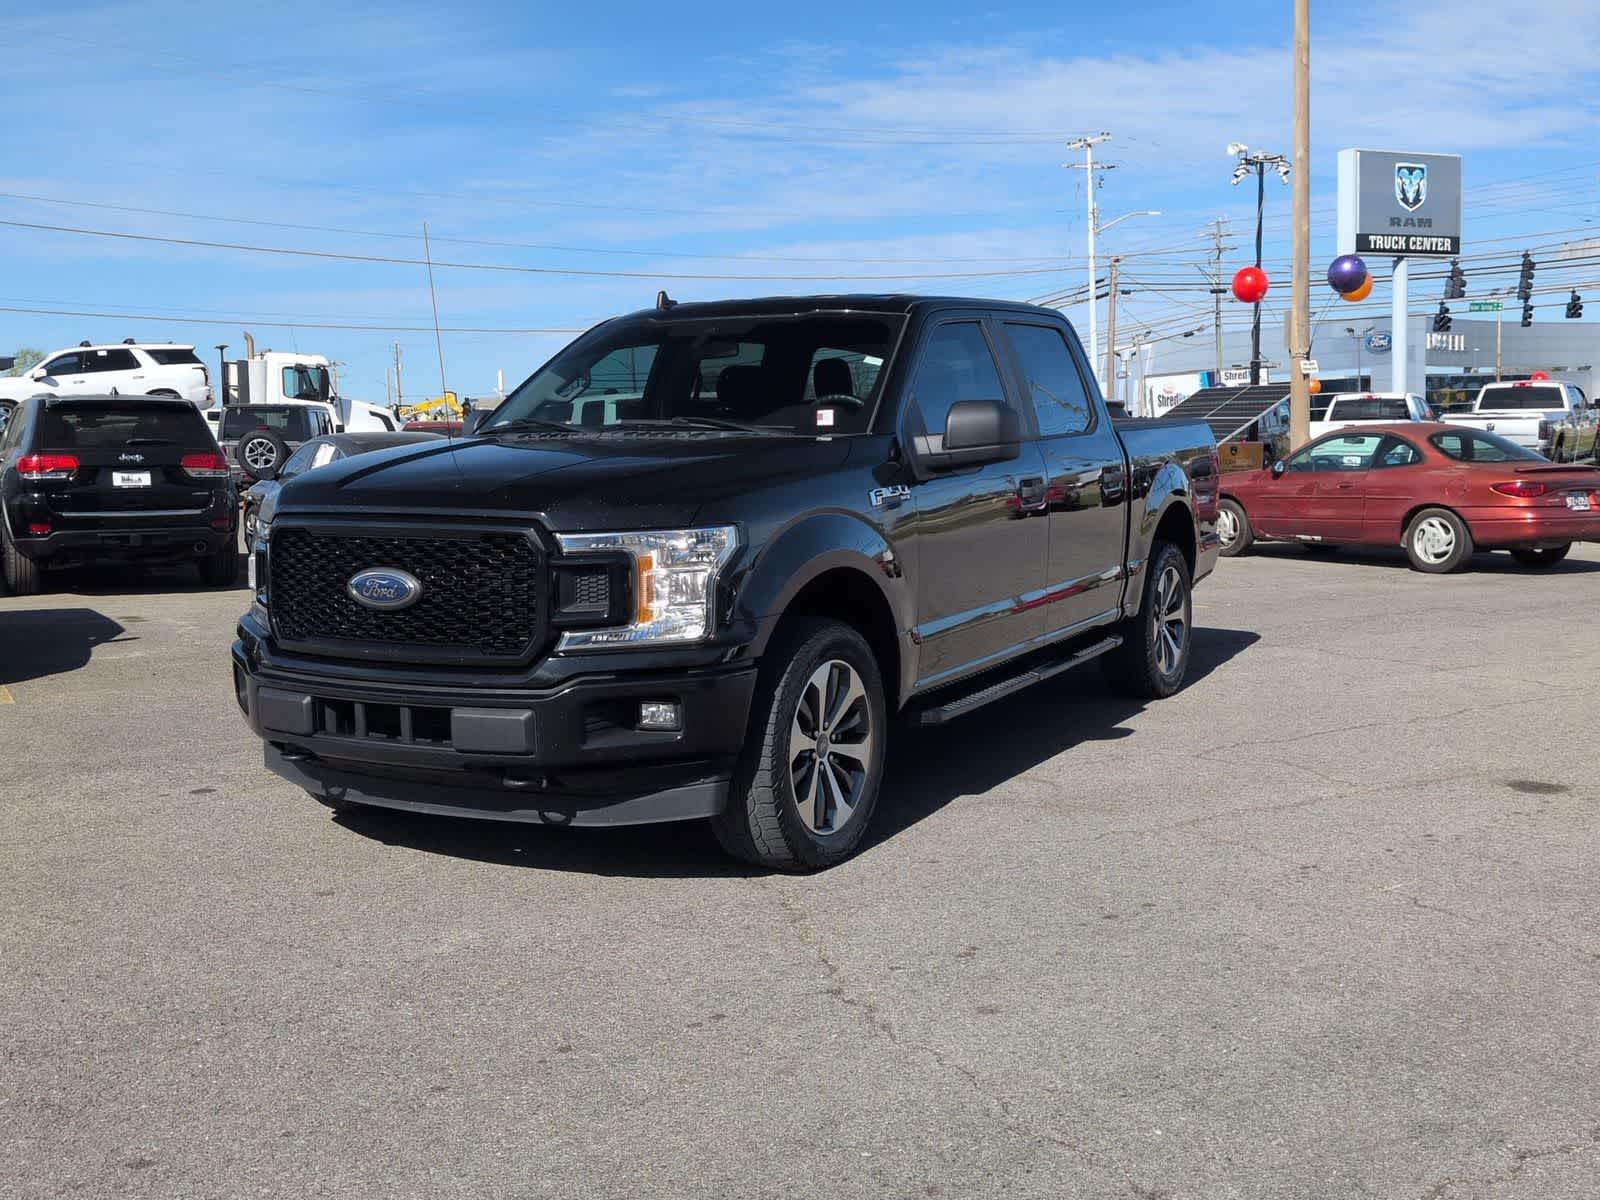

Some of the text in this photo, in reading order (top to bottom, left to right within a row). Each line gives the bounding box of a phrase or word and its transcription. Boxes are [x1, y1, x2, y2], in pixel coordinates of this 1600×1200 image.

[1389, 217, 1433, 228] RAM
[1368, 235, 1452, 252] TRUCK CENTER
[363, 578, 397, 598] Ford
